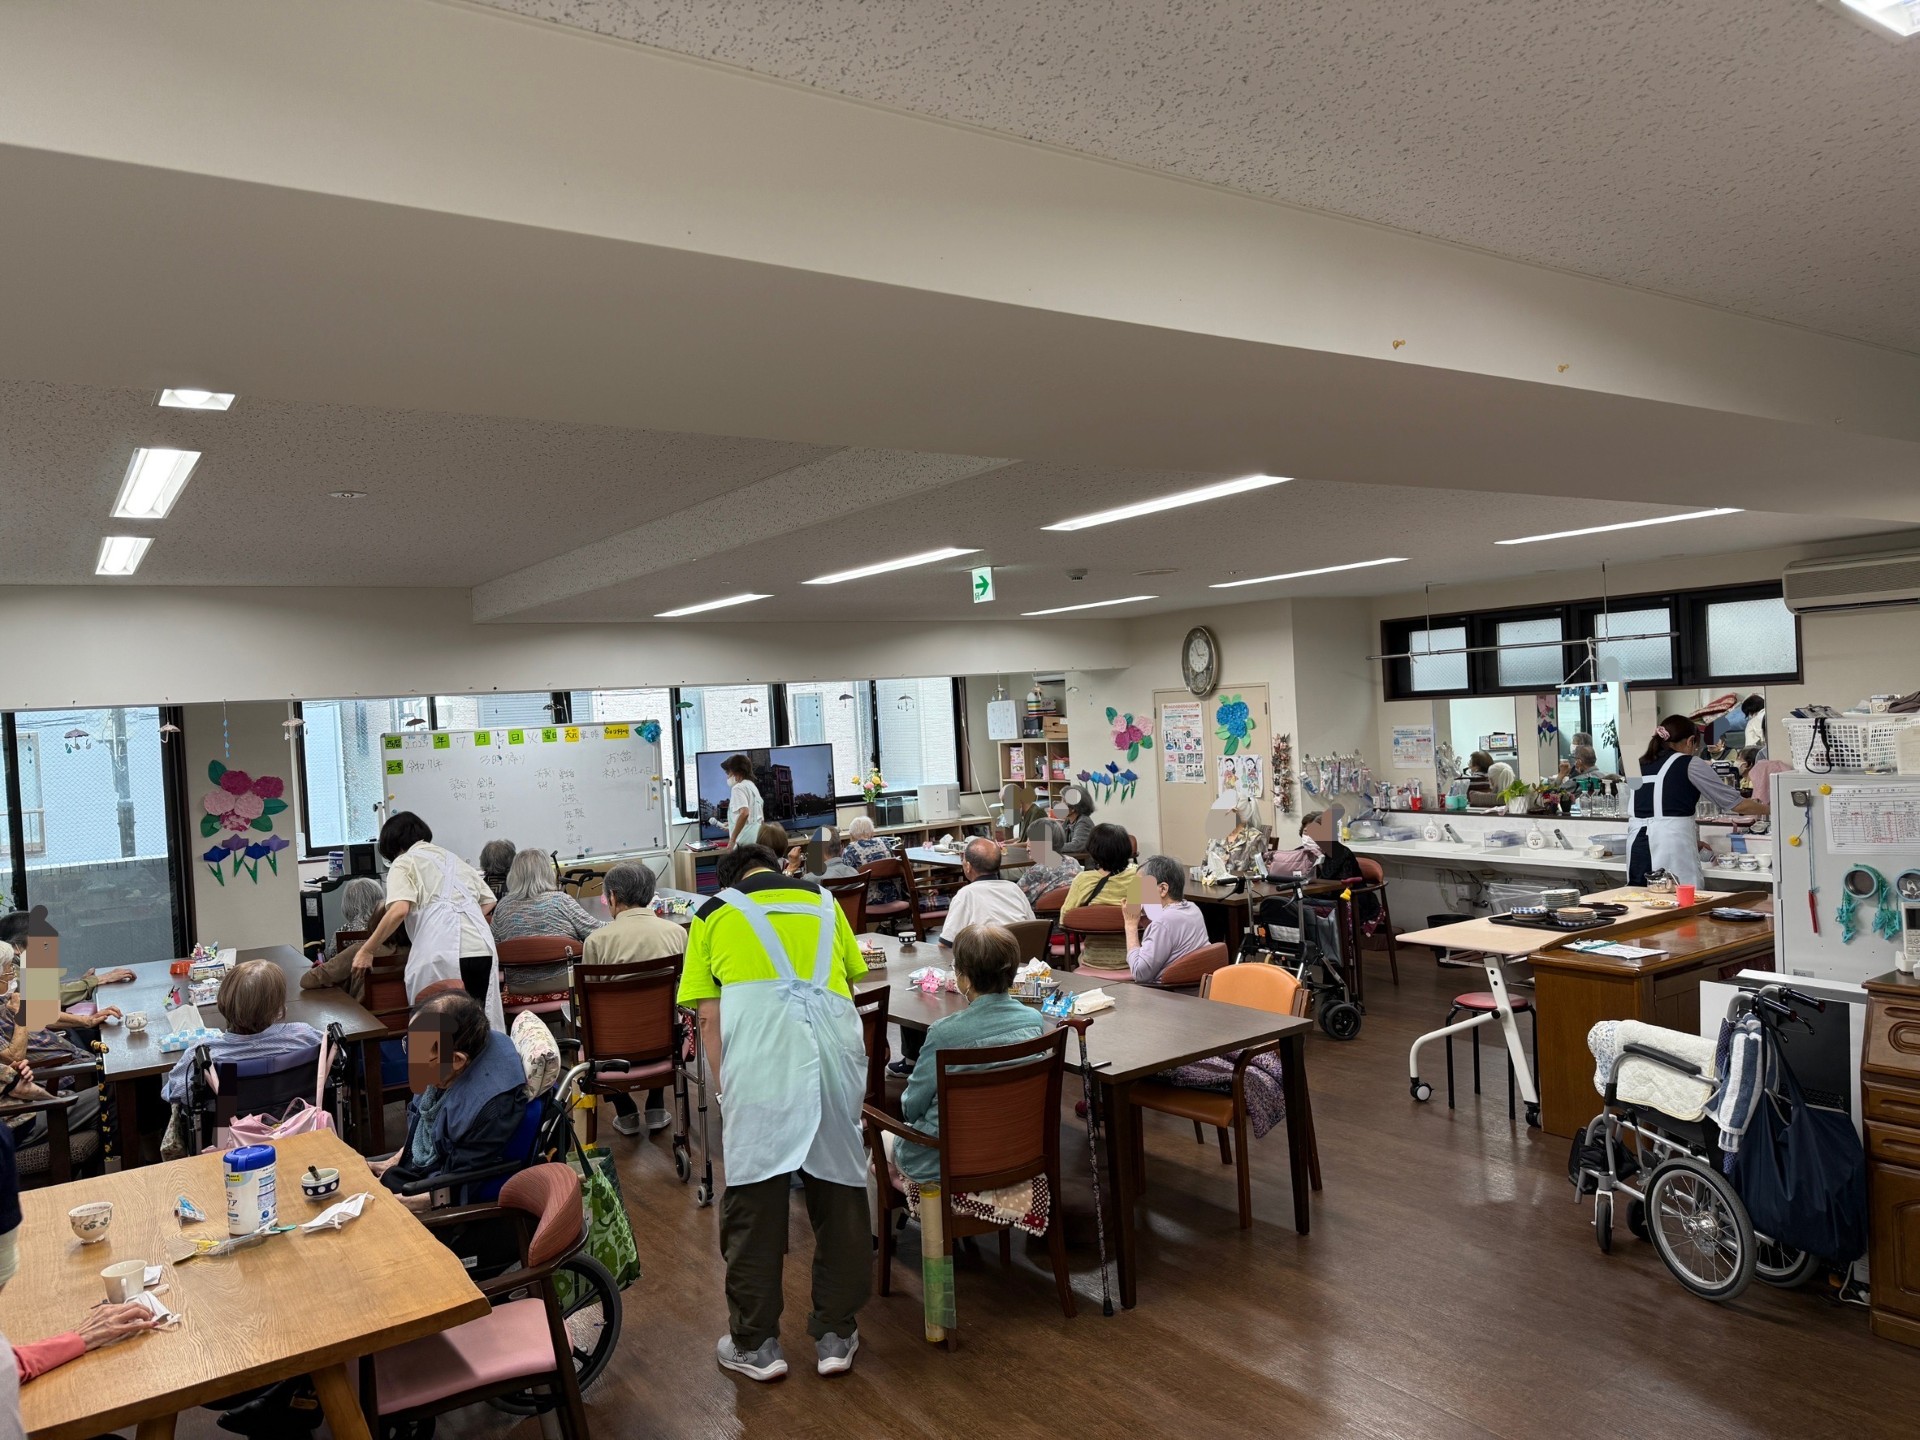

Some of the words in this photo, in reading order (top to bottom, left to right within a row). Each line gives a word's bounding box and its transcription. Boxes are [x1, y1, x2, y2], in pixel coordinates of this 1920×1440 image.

[436, 736, 446, 748] 年
[478, 733, 487, 743] 月
[512, 733, 520, 742] 日
[387, 762, 402, 772] 元号
